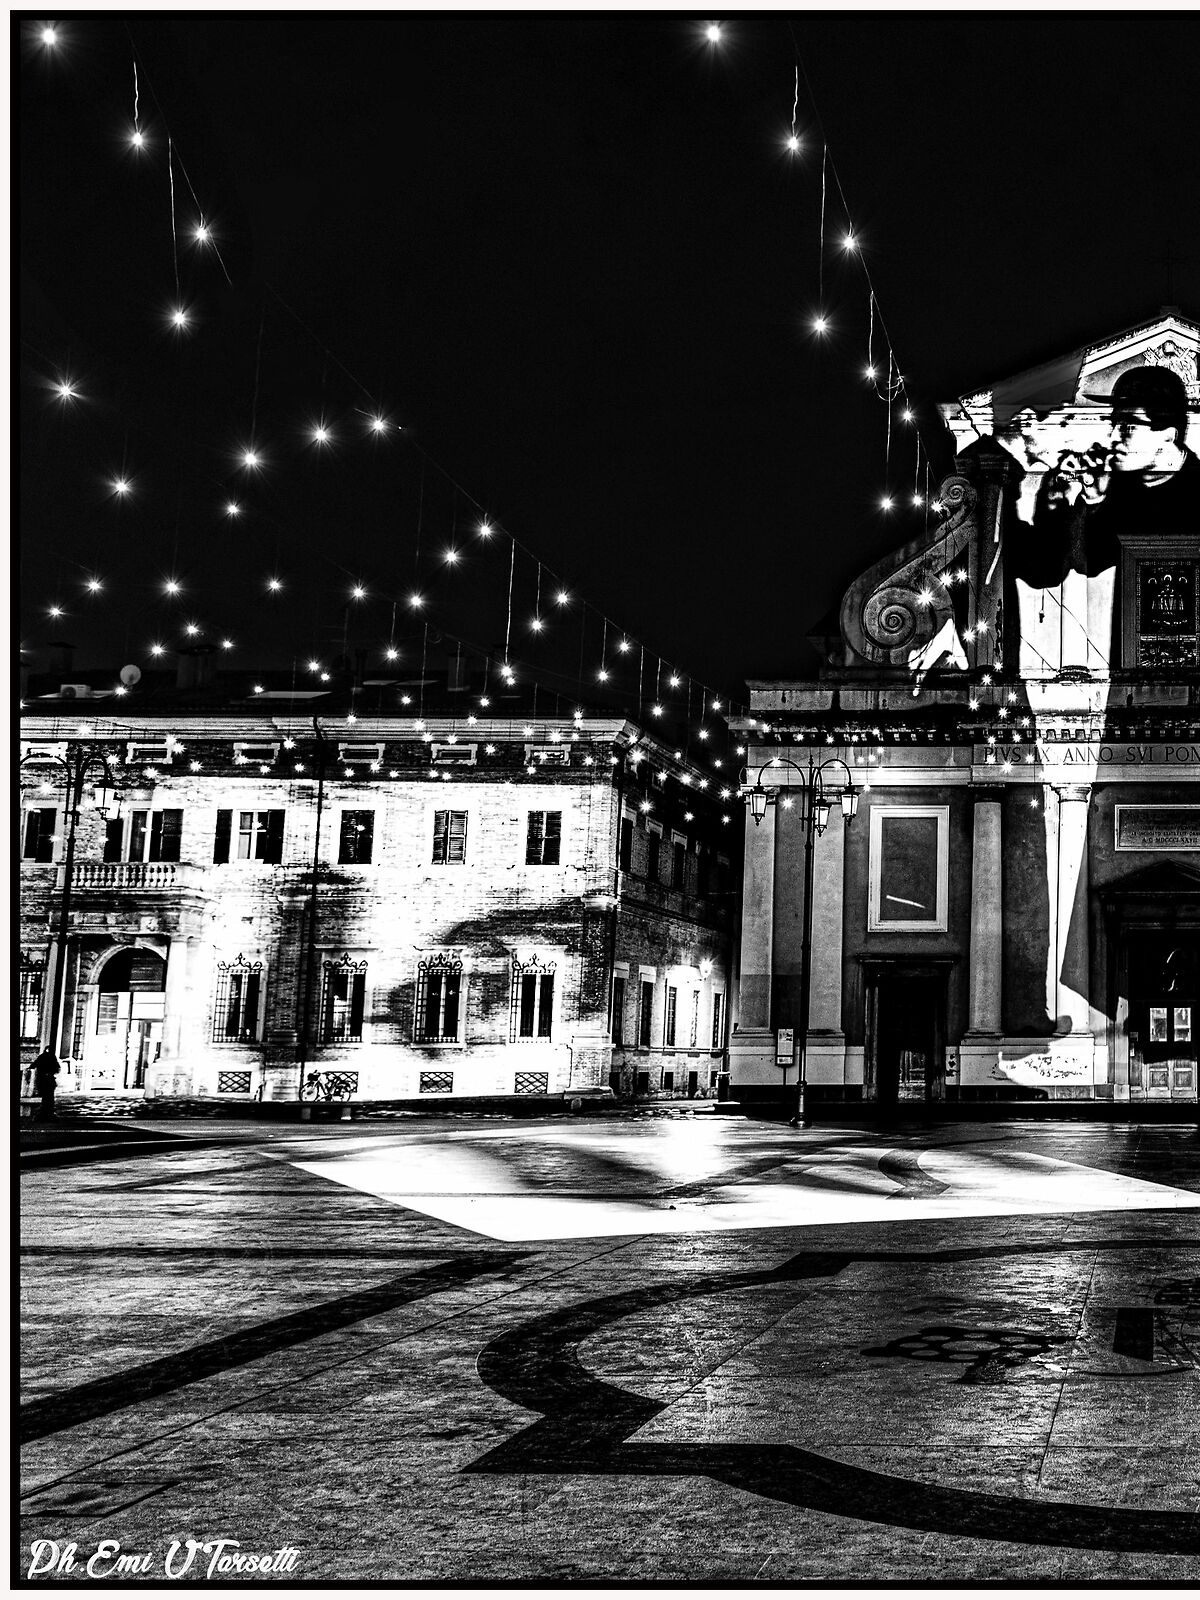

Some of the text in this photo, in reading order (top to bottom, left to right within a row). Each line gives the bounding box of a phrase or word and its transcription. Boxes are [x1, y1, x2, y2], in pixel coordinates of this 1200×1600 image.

[984, 746, 1022, 762] PIVS
[1034, 746, 1050, 763] IX
[1063, 746, 1113, 762] ANNO
[1125, 746, 1153, 762] SVI
